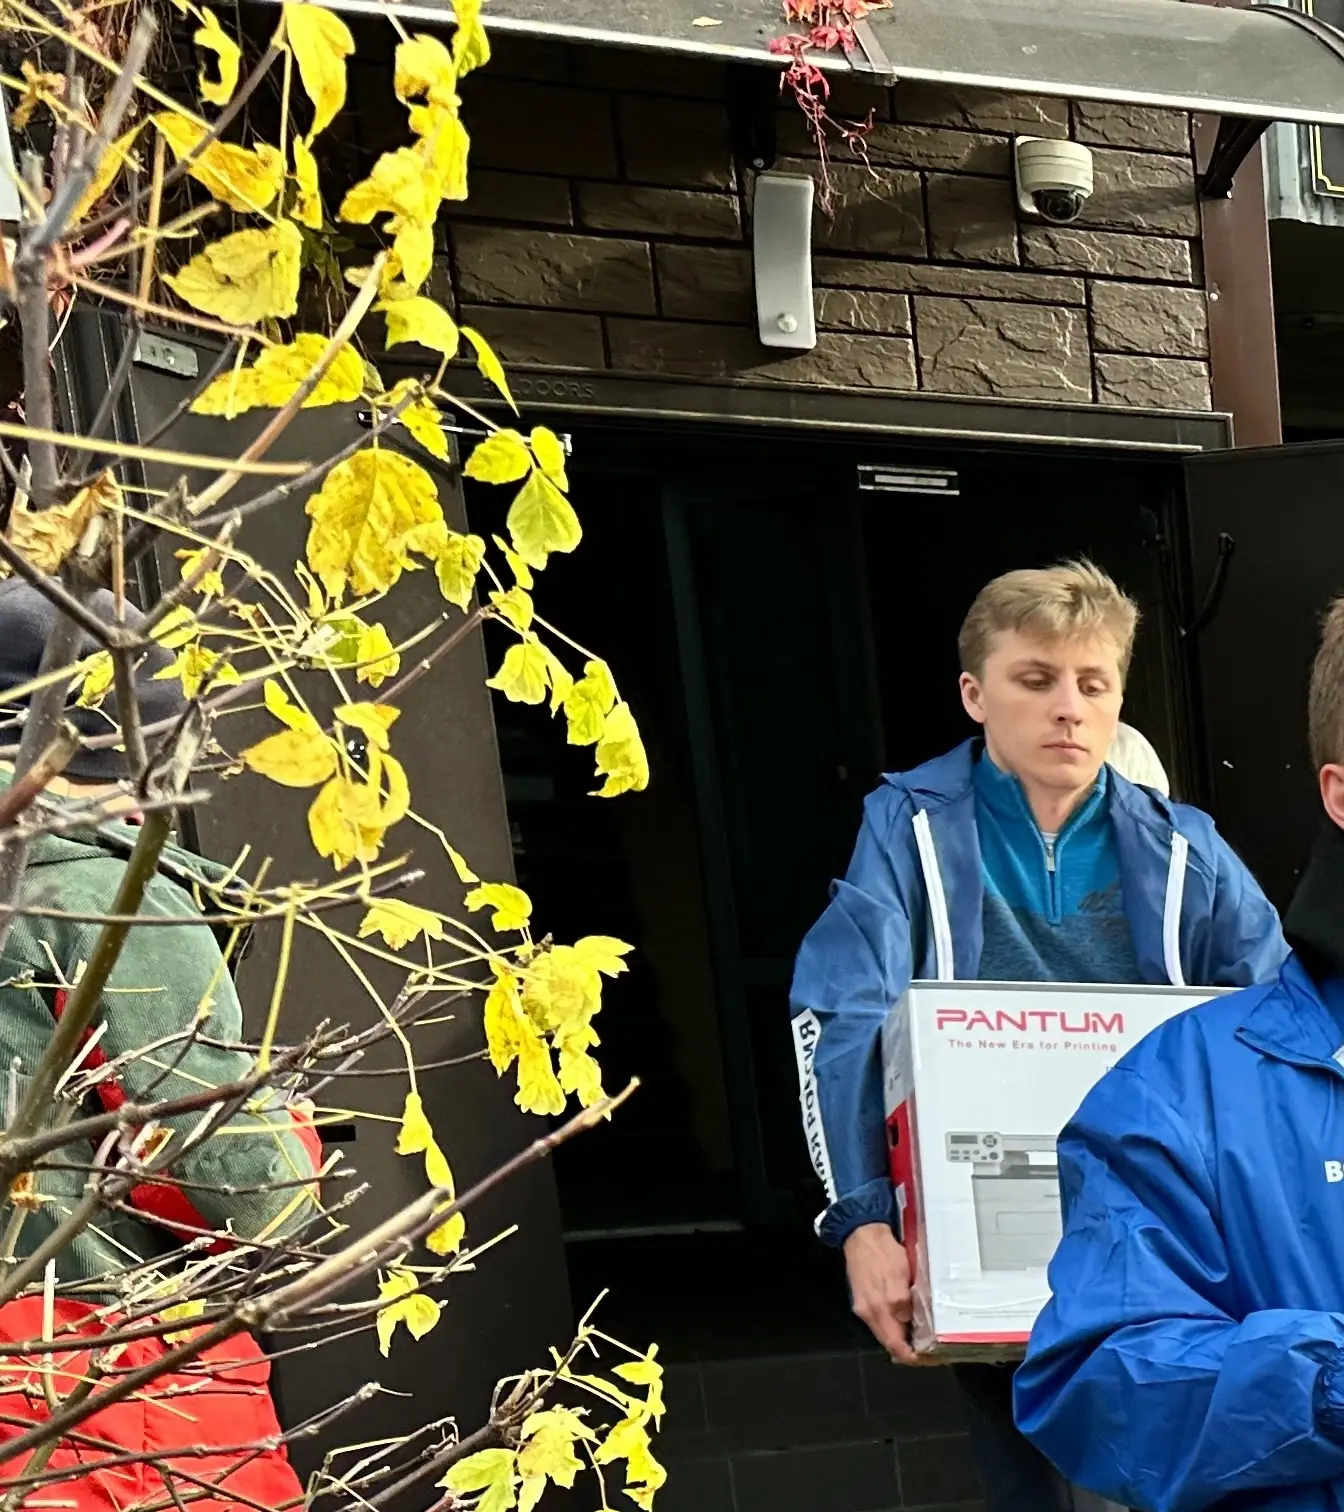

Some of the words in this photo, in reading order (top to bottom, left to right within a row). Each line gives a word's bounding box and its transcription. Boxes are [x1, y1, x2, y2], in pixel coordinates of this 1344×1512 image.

[936, 1009, 1124, 1033] PANTUM
[948, 1039, 972, 1049] The
[979, 1039, 1006, 1049] New
[1012, 1040, 1034, 1050] Era
[1040, 1040, 1058, 1050] for
[1064, 1041, 1117, 1053] Printing
